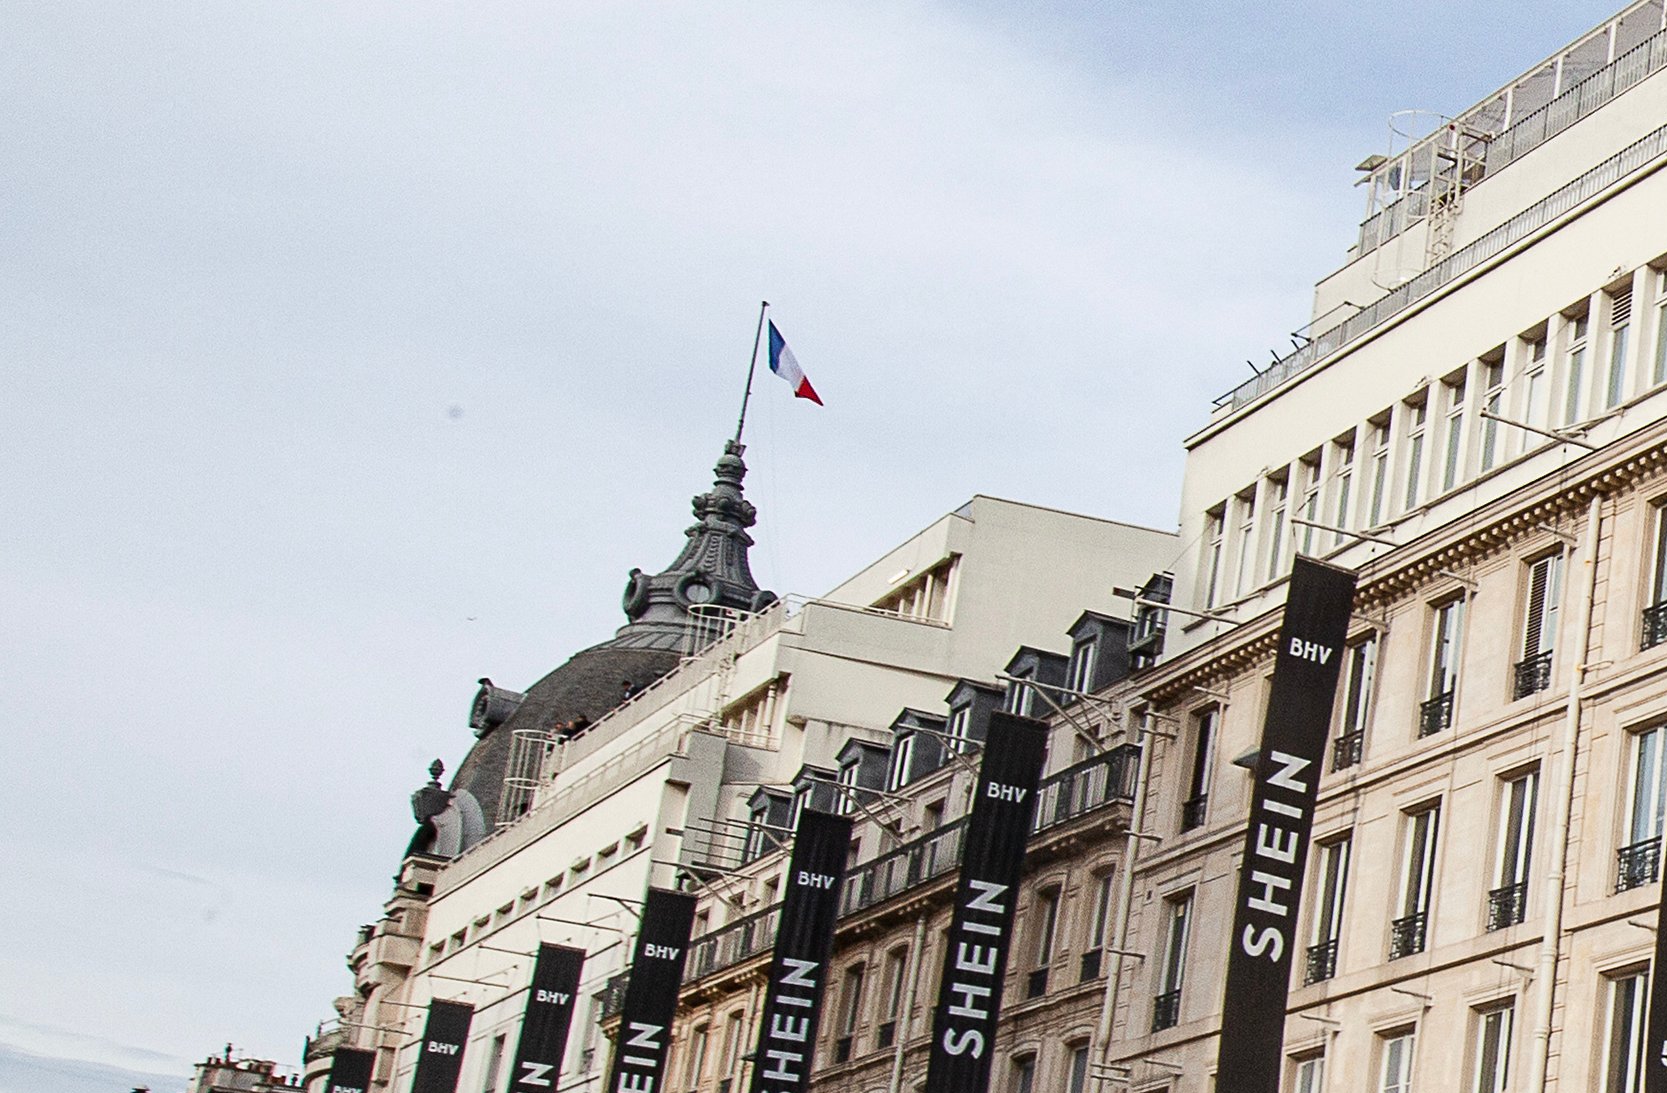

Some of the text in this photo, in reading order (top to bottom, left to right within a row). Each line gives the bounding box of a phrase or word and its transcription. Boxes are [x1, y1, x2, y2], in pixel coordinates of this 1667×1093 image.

[1290, 638, 1332, 664] BHV
[987, 782, 1026, 802] BHV
[1243, 751, 1311, 962] SHEIN
[798, 871, 834, 889] BHV
[645, 944, 679, 960] BHV
[944, 880, 1008, 1059] SHEIN
[537, 990, 569, 1004] BHV
[428, 1041, 459, 1055] BHV
